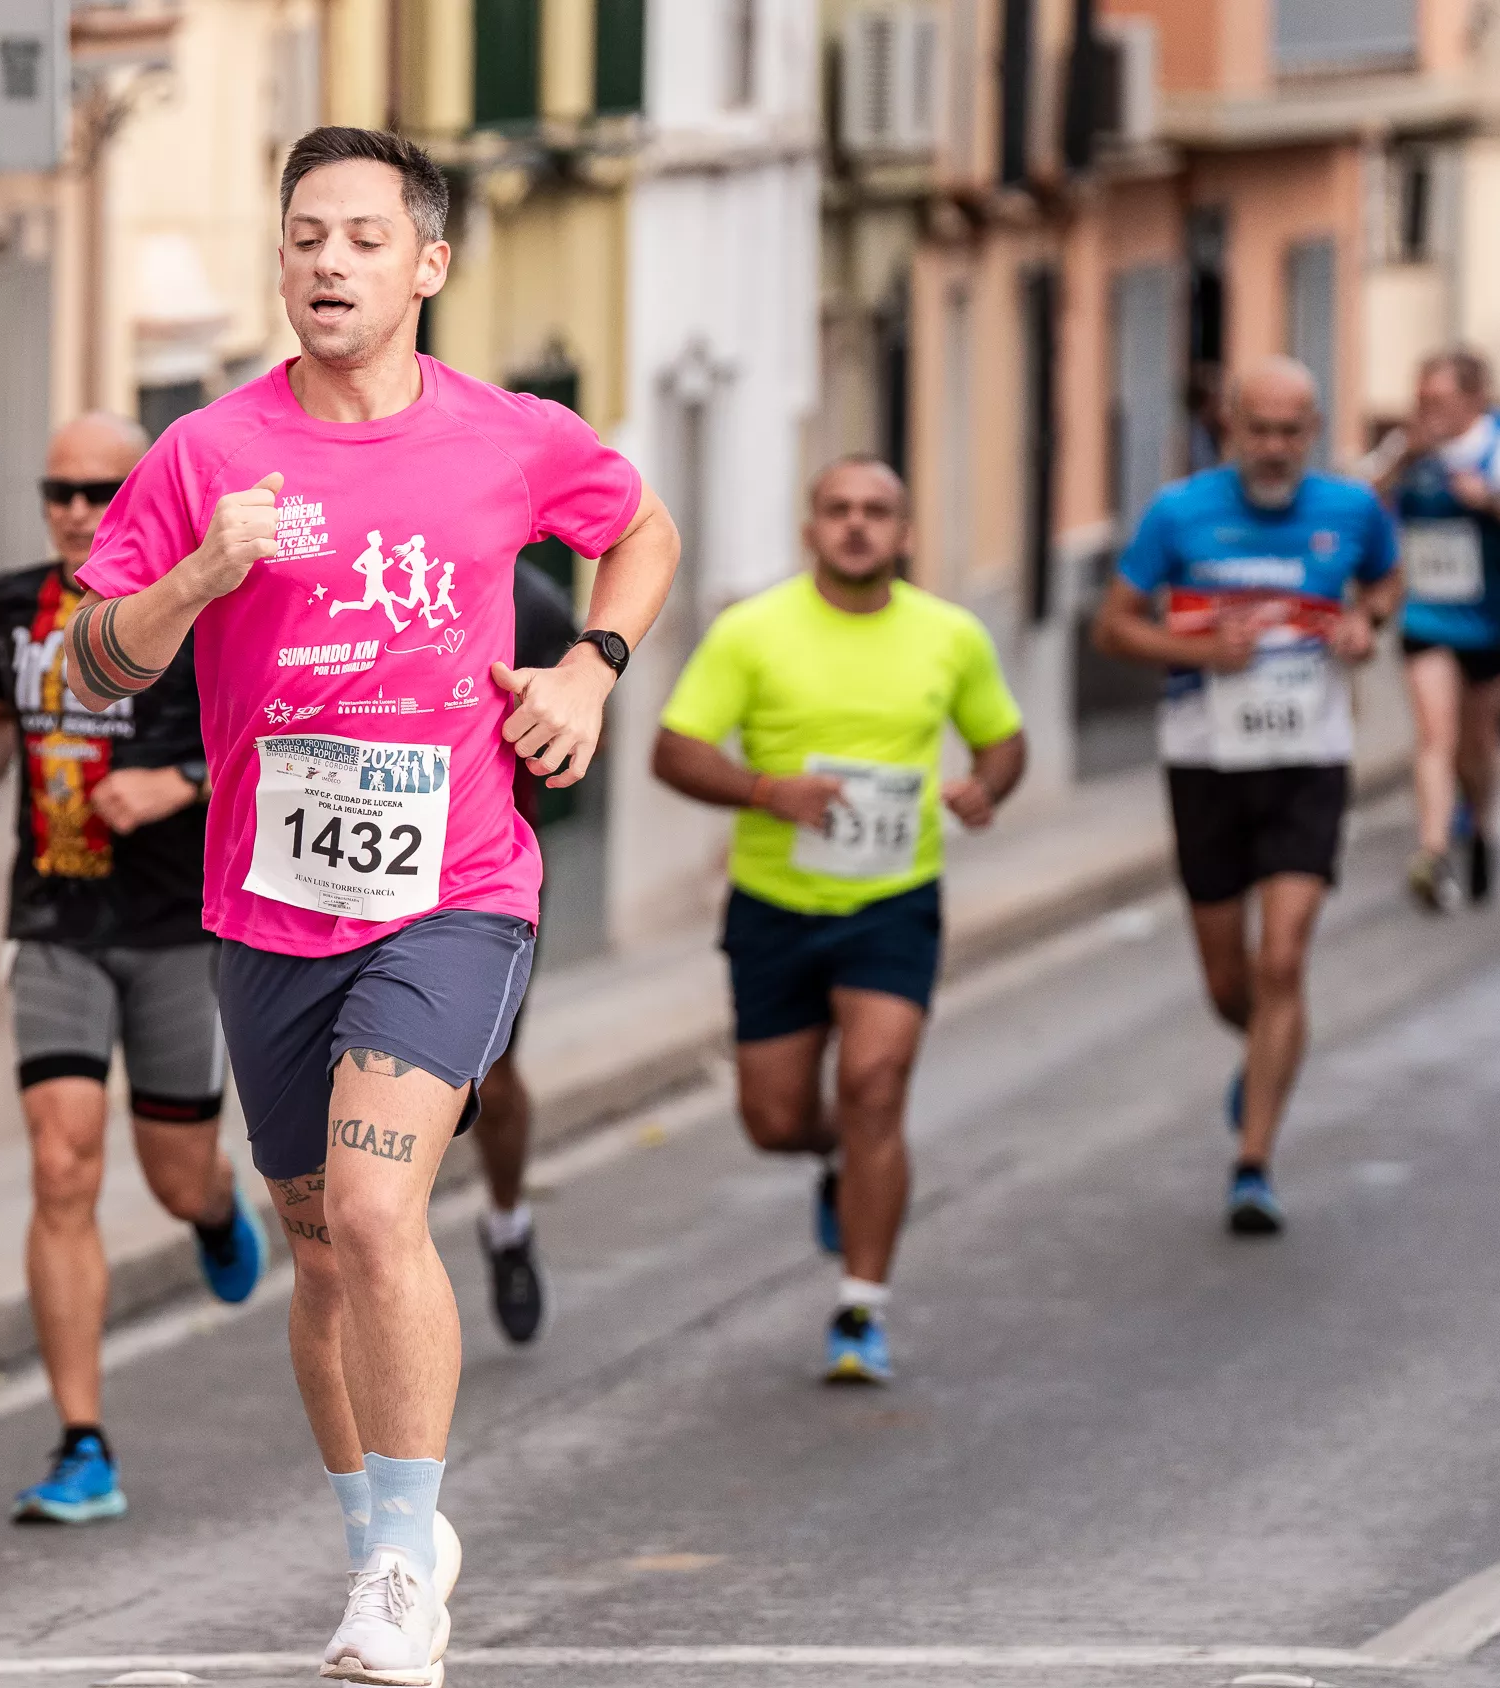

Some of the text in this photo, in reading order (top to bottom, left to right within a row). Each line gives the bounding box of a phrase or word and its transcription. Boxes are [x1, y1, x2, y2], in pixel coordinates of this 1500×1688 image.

[282, 495, 303, 506] XXV
[277, 503, 322, 521] ARRERA
[276, 516, 326, 530] OPULAR
[277, 533, 328, 550] UCENA
[278, 640, 380, 667] SUMANDO KM
[313, 665, 330, 676] POR
[330, 664, 341, 675] LA
[266, 744, 359, 765] CARRERAS POPULARES
[303, 739, 348, 754] PROVINCIAL
[349, 746, 360, 756] DE
[313, 757, 321, 766] DE
[359, 748, 410, 769] 2024
[304, 788, 403, 808] XXV C.P. CIUDAD DE LUCENA
[318, 801, 383, 817] POR LA IGUALDAD
[284, 807, 422, 876] 1432
[294, 873, 395, 896] JUAN LUIS TORRES GARCÍA
[281, 1214, 331, 1245] LUC
